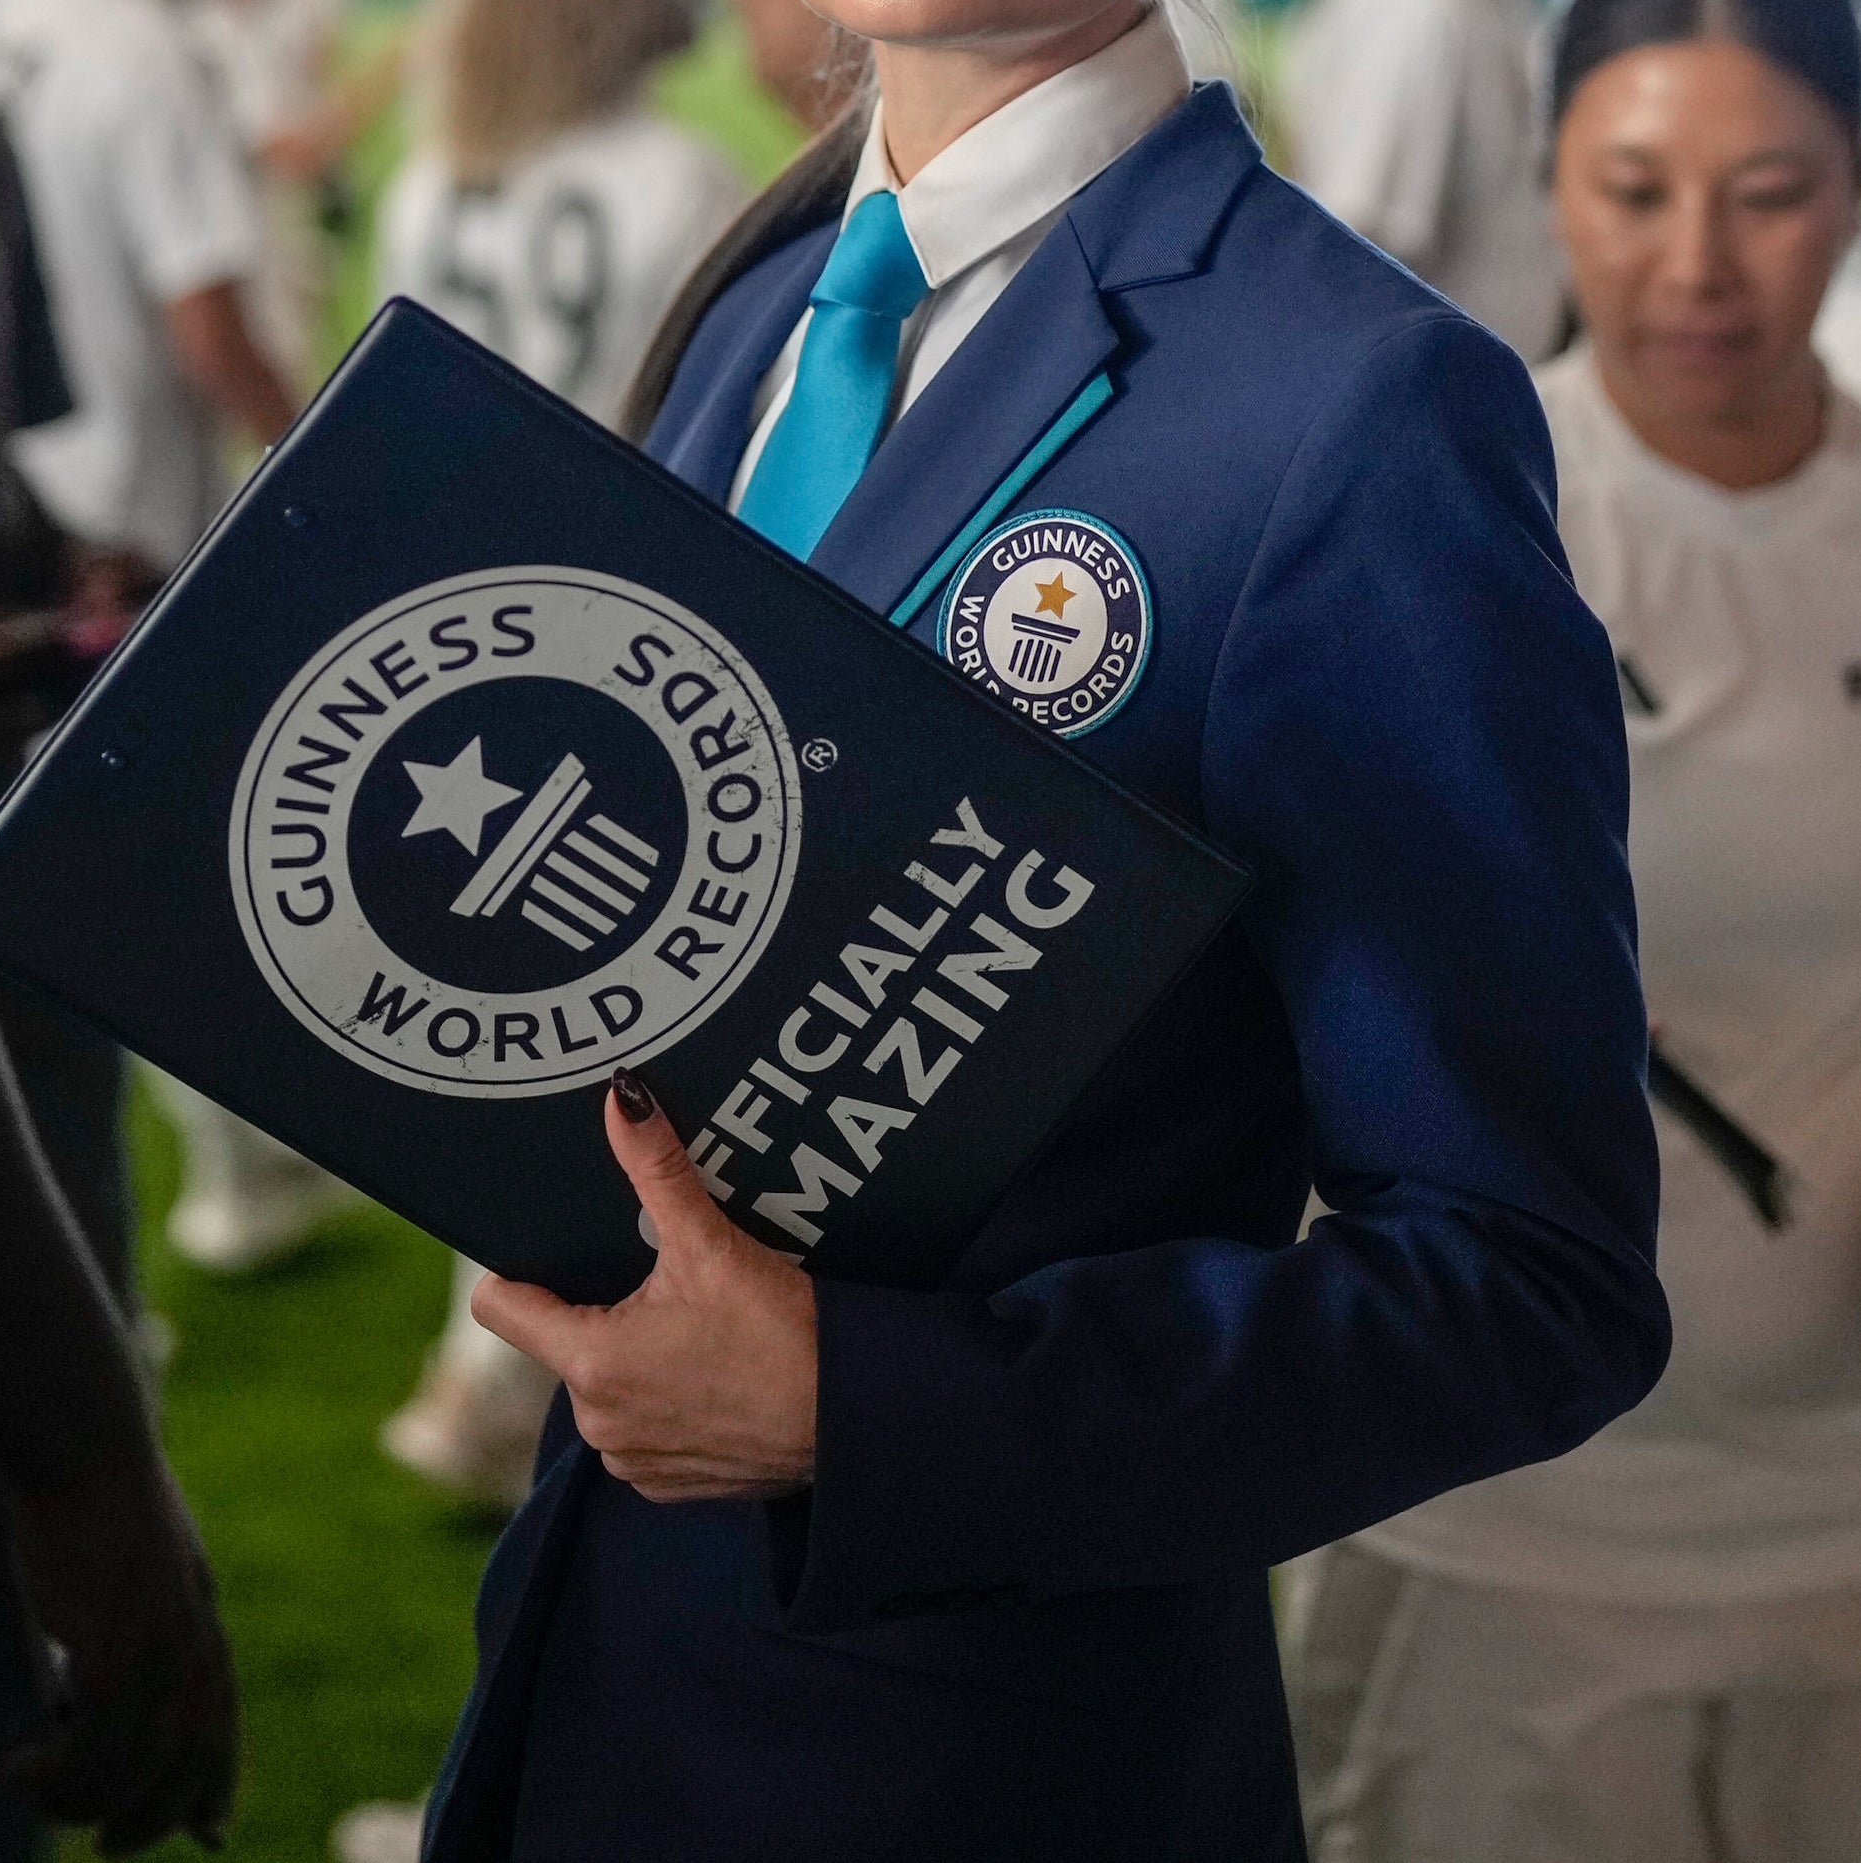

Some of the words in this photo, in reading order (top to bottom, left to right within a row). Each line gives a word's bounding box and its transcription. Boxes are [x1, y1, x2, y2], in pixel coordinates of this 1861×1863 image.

[270, 604, 536, 928] GUINNESS
[992, 528, 1131, 601] GUINNESS
[355, 971, 644, 1064] WORLD
[612, 633, 762, 981] RECORDS
[638, 795, 1006, 1249] FFICIALLY
[750, 848, 1096, 1267] MAZING
